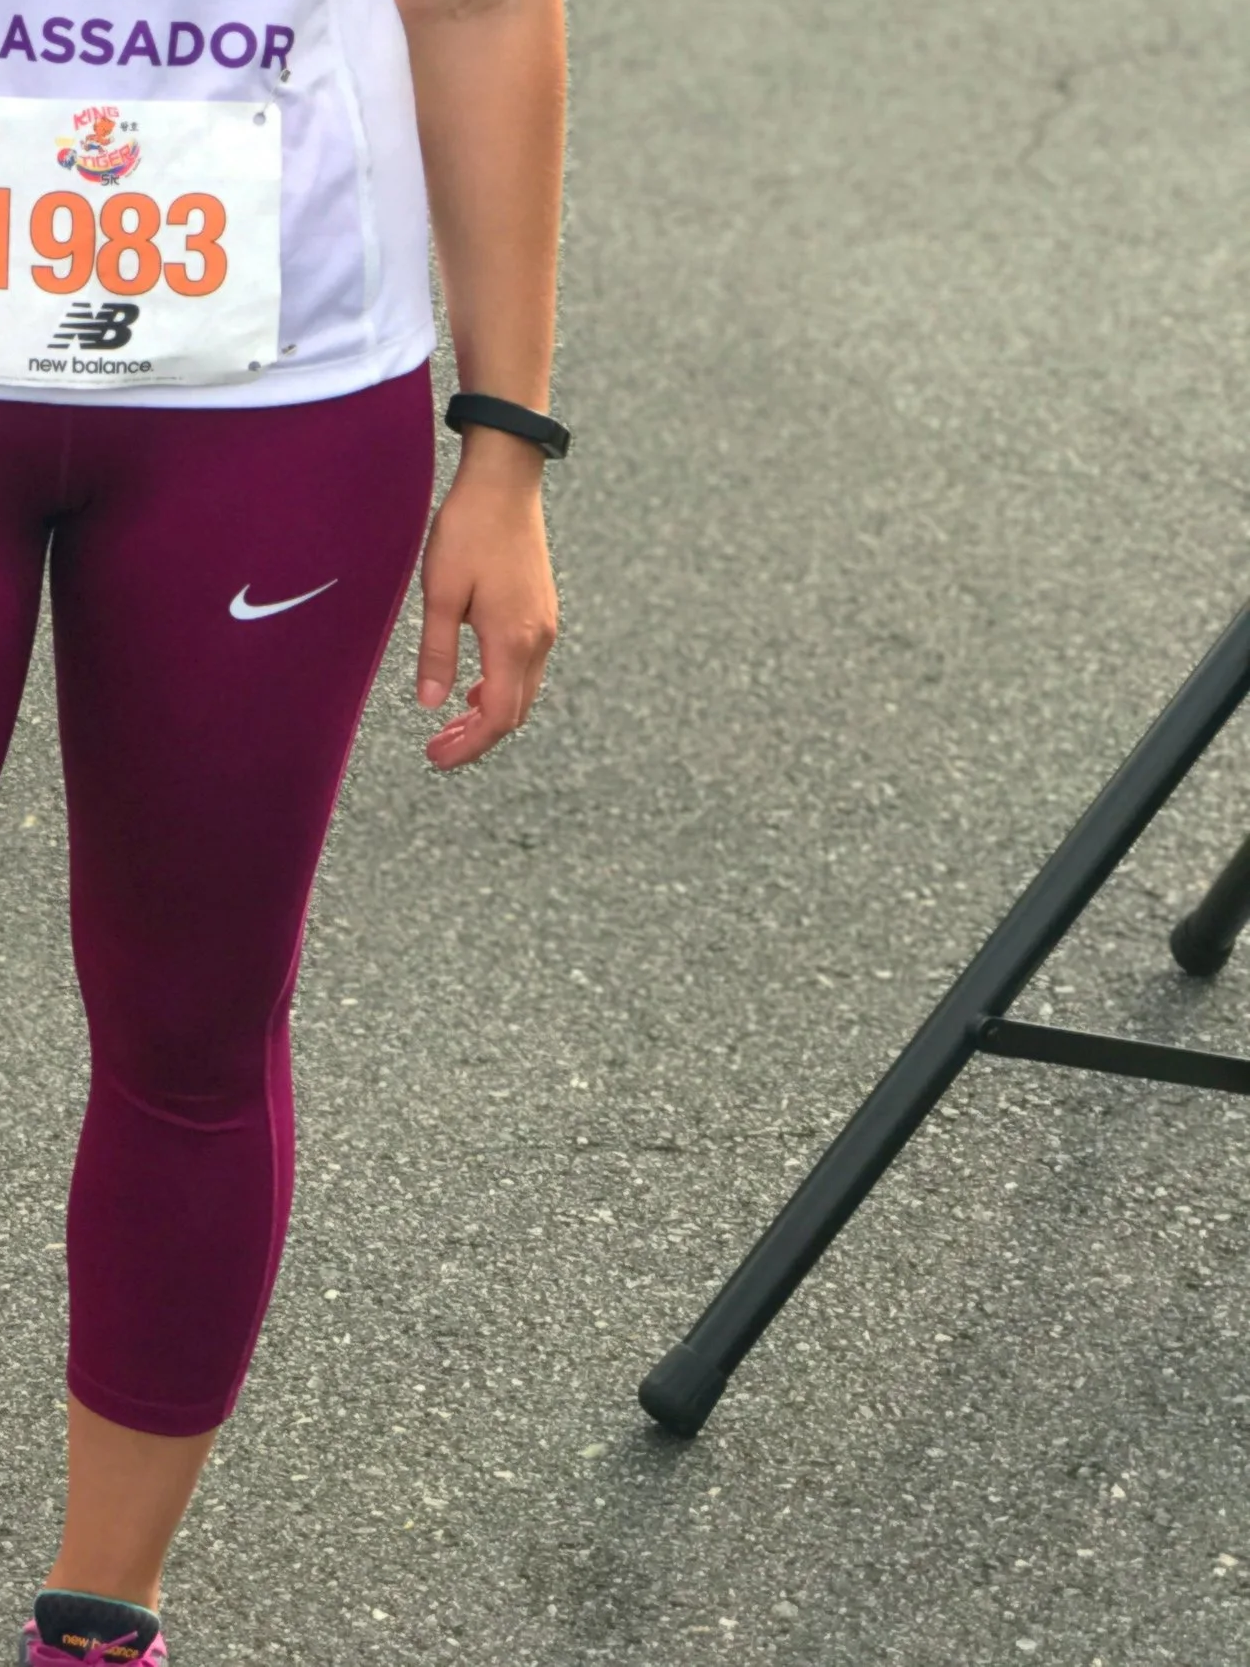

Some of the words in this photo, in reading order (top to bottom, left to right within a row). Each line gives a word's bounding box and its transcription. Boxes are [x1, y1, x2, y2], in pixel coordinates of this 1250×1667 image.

[74, 106, 119, 130] KING
[79, 143, 134, 169] TIGER
[100, 174, 120, 186] 5K
[28, 357, 68, 373] new
[62, 1634, 89, 1647] new
